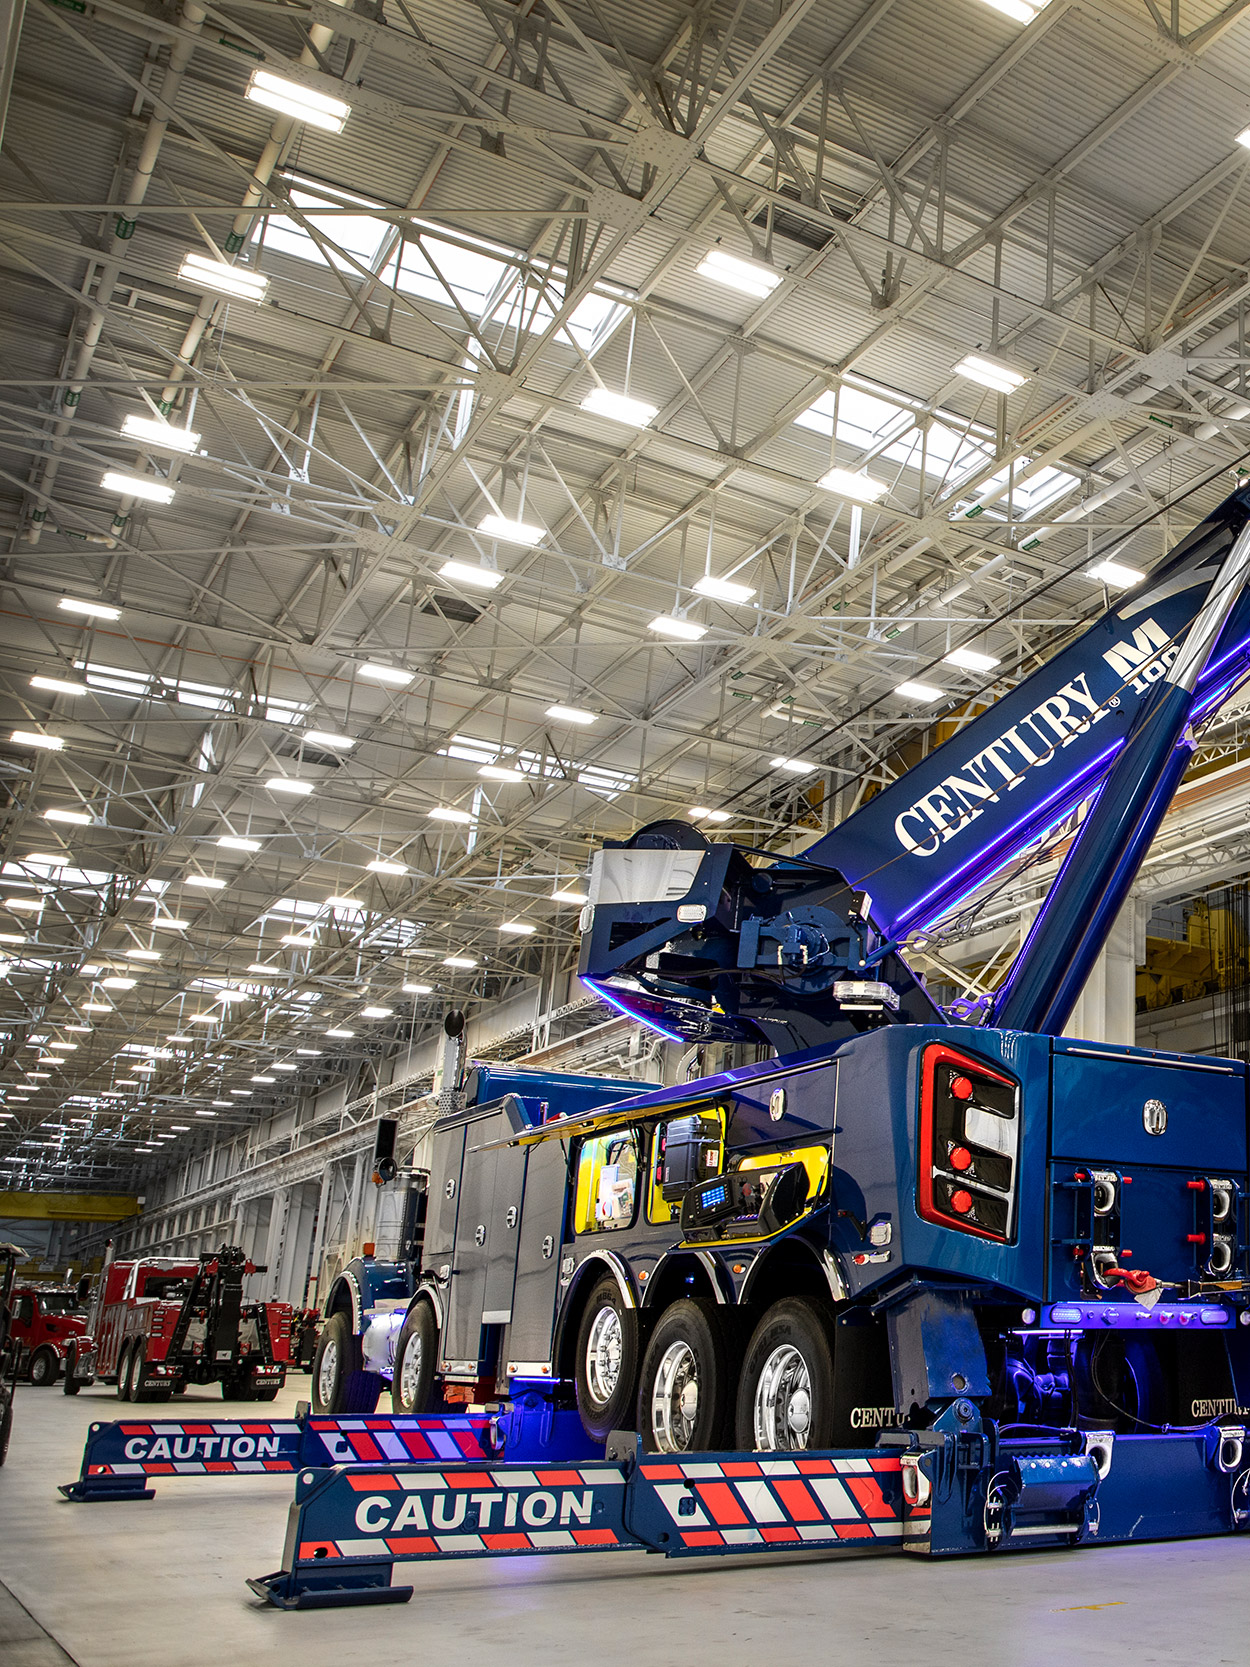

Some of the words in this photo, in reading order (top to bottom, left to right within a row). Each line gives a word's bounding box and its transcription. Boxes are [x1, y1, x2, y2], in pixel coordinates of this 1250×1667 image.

[894, 672, 1111, 857] CENTURY
[1102, 617, 1171, 678] M
[850, 1407, 911, 1429] CENTU
[124, 1436, 281, 1460] CAUTION
[354, 1490, 594, 1533] CAUTION
